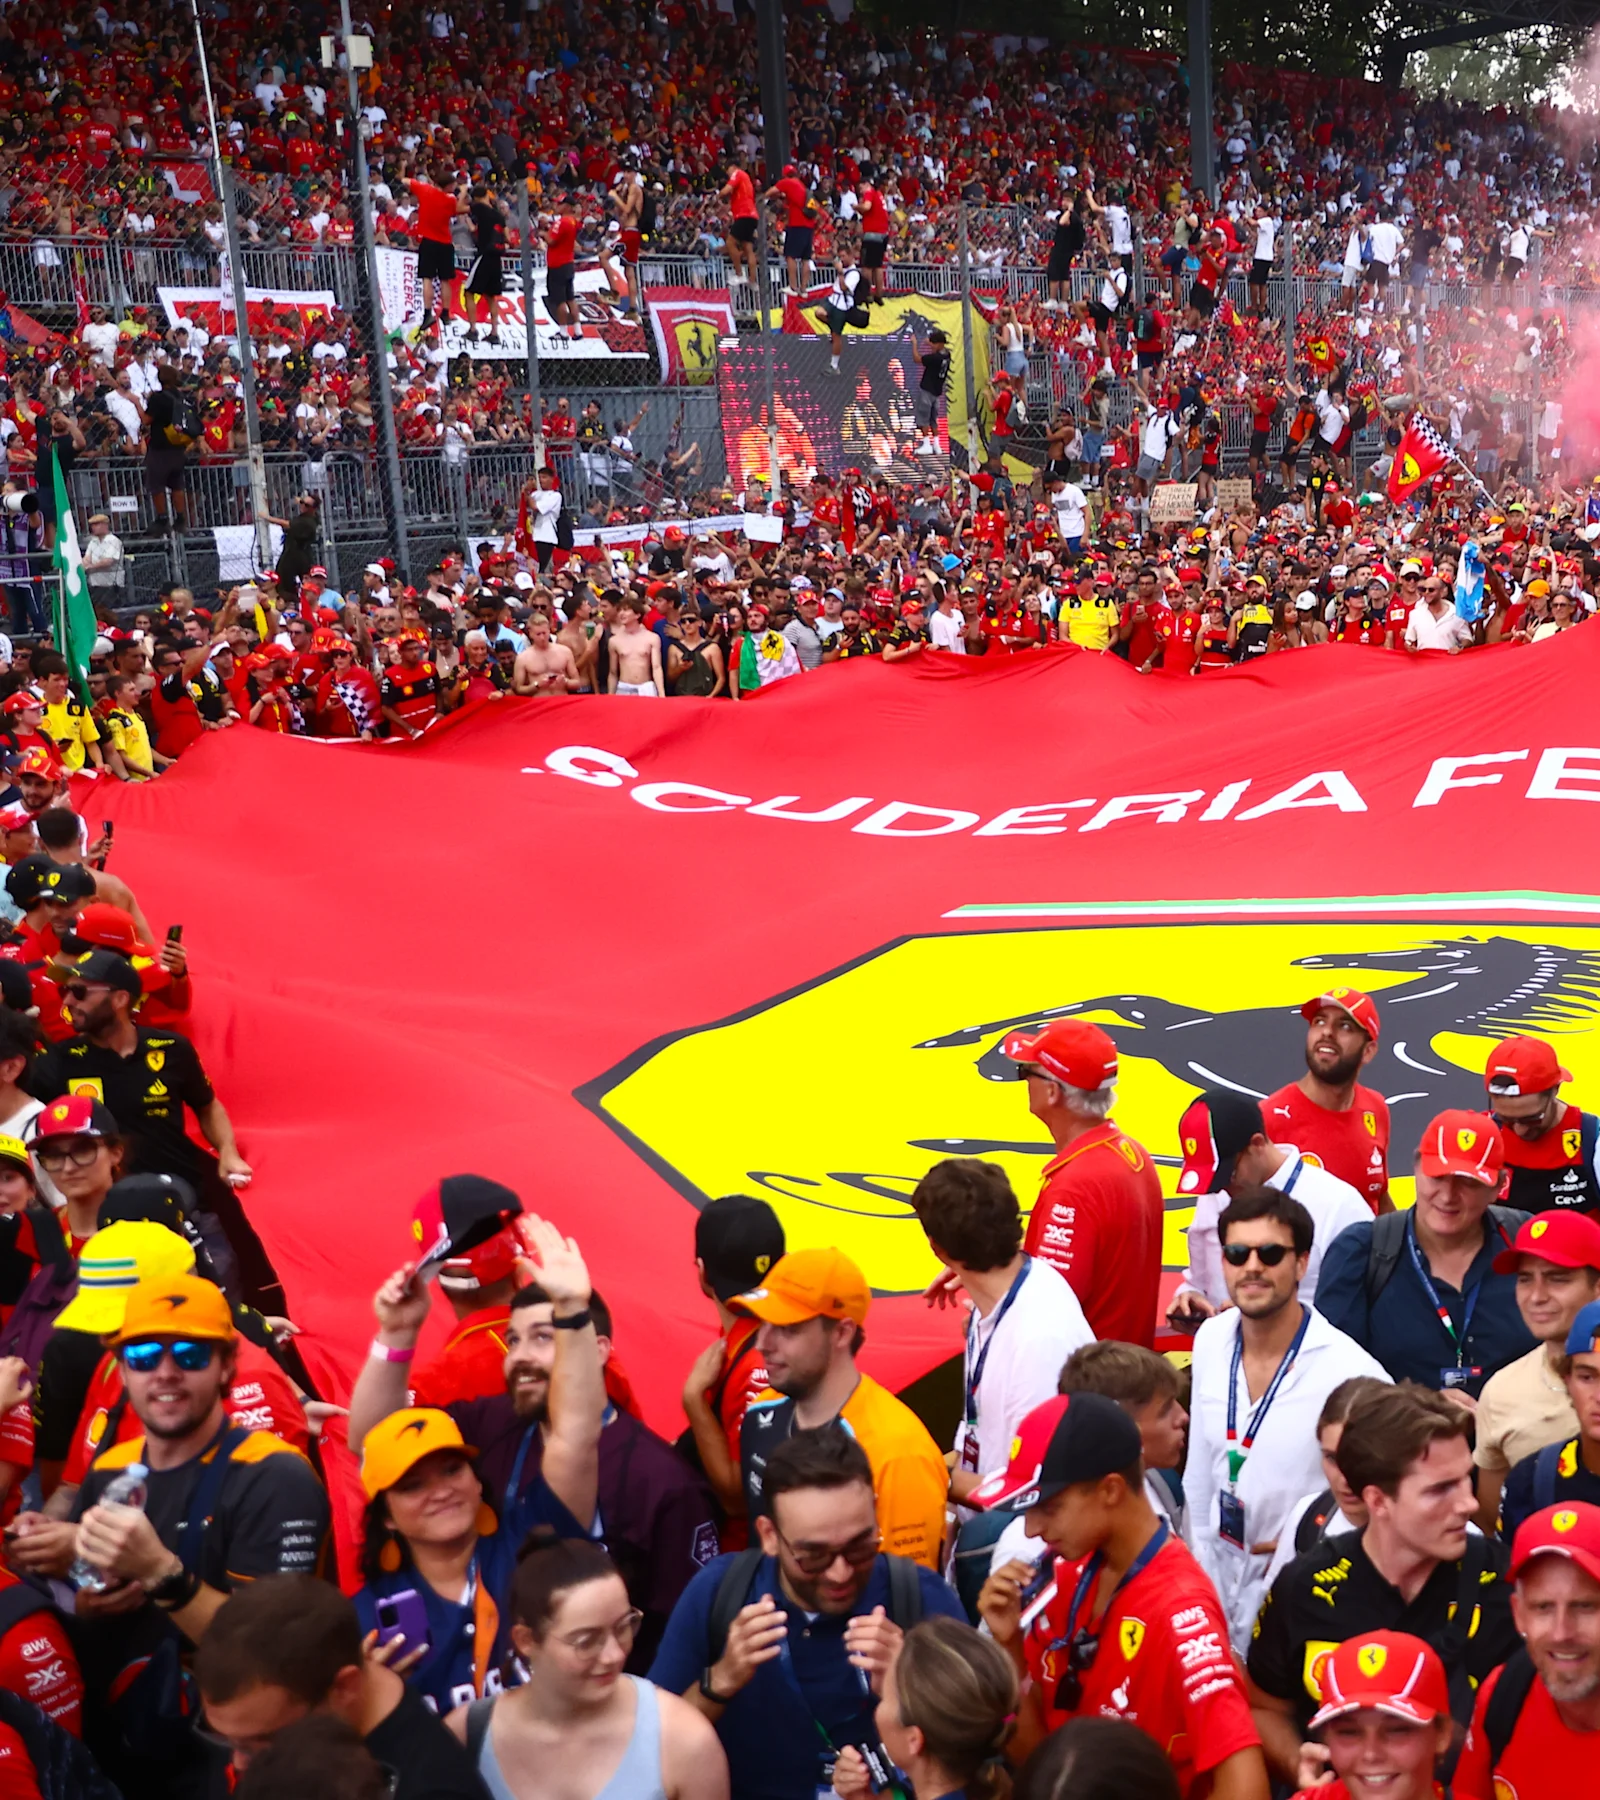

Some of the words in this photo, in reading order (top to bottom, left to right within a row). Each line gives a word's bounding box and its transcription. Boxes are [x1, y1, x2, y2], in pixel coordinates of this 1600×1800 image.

[521, 745, 1369, 837] SCUDERIA
[1052, 1203, 1076, 1217] aws
[752, 1368, 769, 1380] aw
[233, 1382, 263, 1399] aws
[1171, 1605, 1206, 1630] aws
[20, 1637, 52, 1657] aws
[1176, 1632, 1223, 1664] DXC
[24, 1660, 67, 1691] DXC
